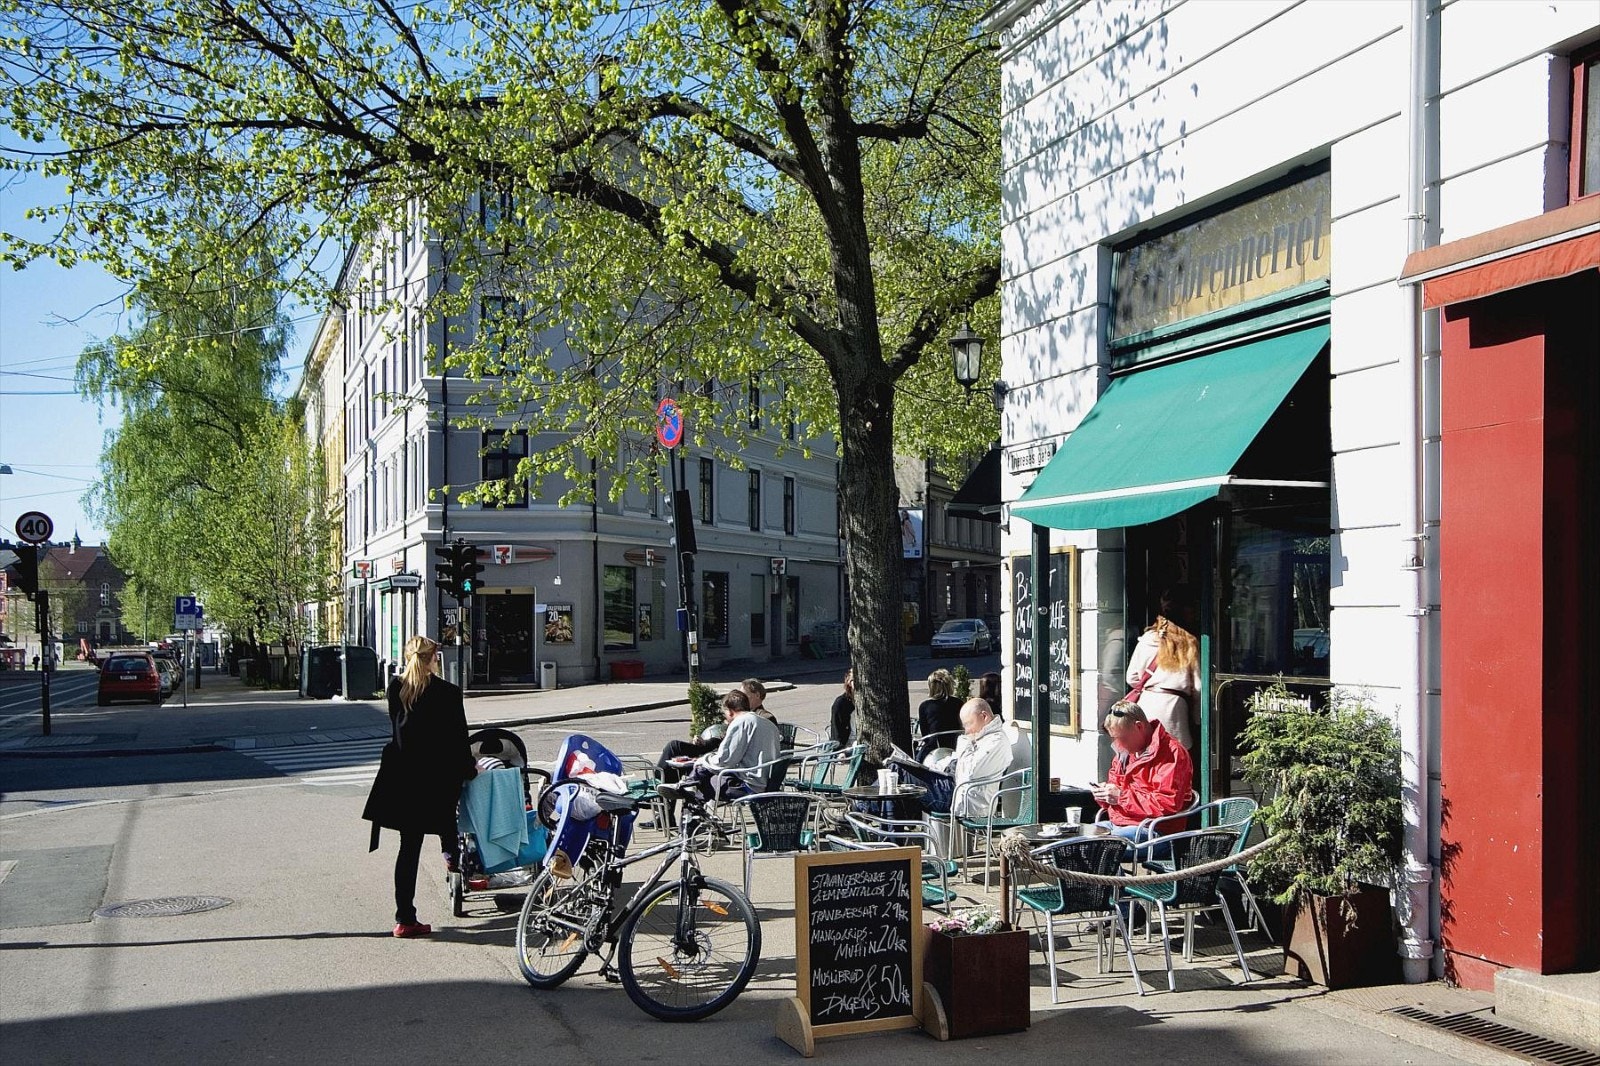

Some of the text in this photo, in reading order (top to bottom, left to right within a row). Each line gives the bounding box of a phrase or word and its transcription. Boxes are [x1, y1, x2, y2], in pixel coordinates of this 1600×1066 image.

[22, 519, 47, 536] 40
[180, 598, 191, 613] P
[818, 992, 880, 1019] DAGENS
